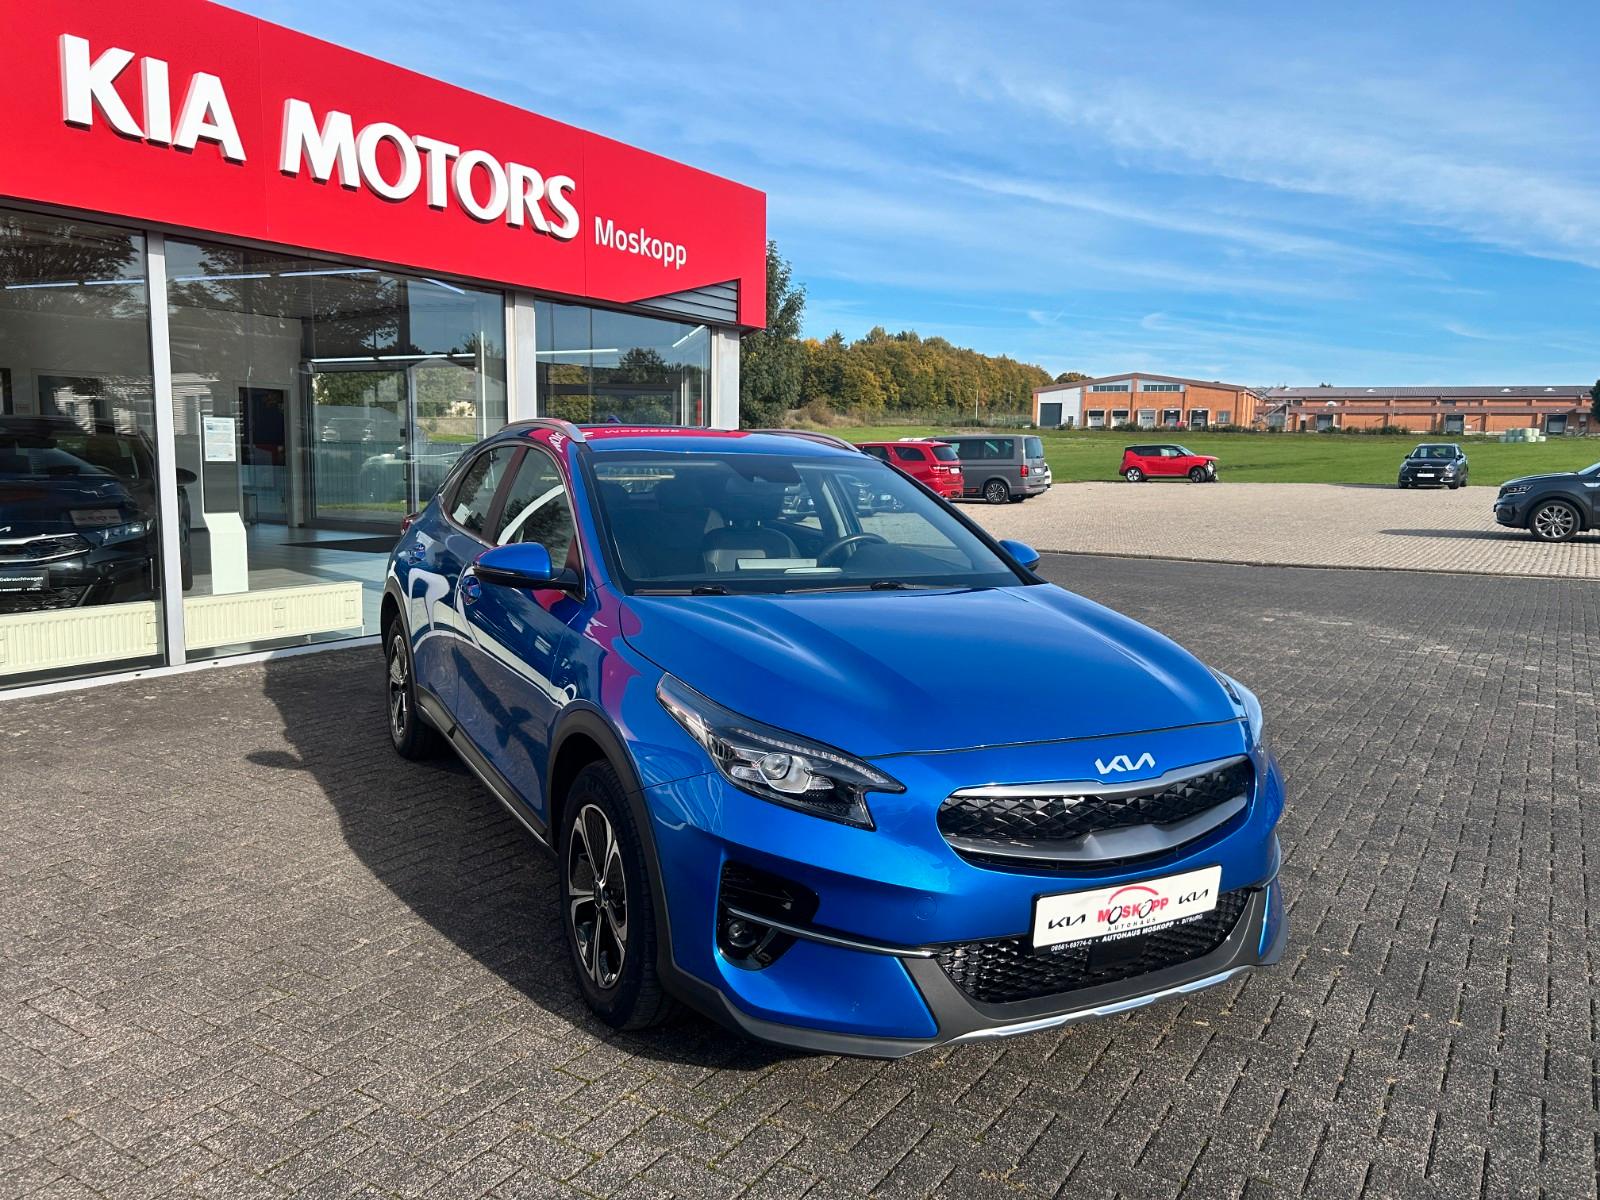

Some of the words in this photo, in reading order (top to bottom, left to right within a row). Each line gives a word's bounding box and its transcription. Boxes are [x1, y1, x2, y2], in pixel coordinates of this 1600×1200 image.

[59, 33, 246, 163] KIA
[280, 97, 580, 240] MOTORS
[594, 216, 687, 270] Moskopp
[1095, 752, 1156, 775] KIA
[1179, 889, 1209, 904] KIA
[1048, 914, 1086, 929] KIA
[1097, 897, 1169, 925] MOSKOPP
[1102, 929, 1141, 942] AUTOHAUS
[1142, 921, 1174, 934] MOSKOPP
[1107, 918, 1156, 932] AUTOHAUS
